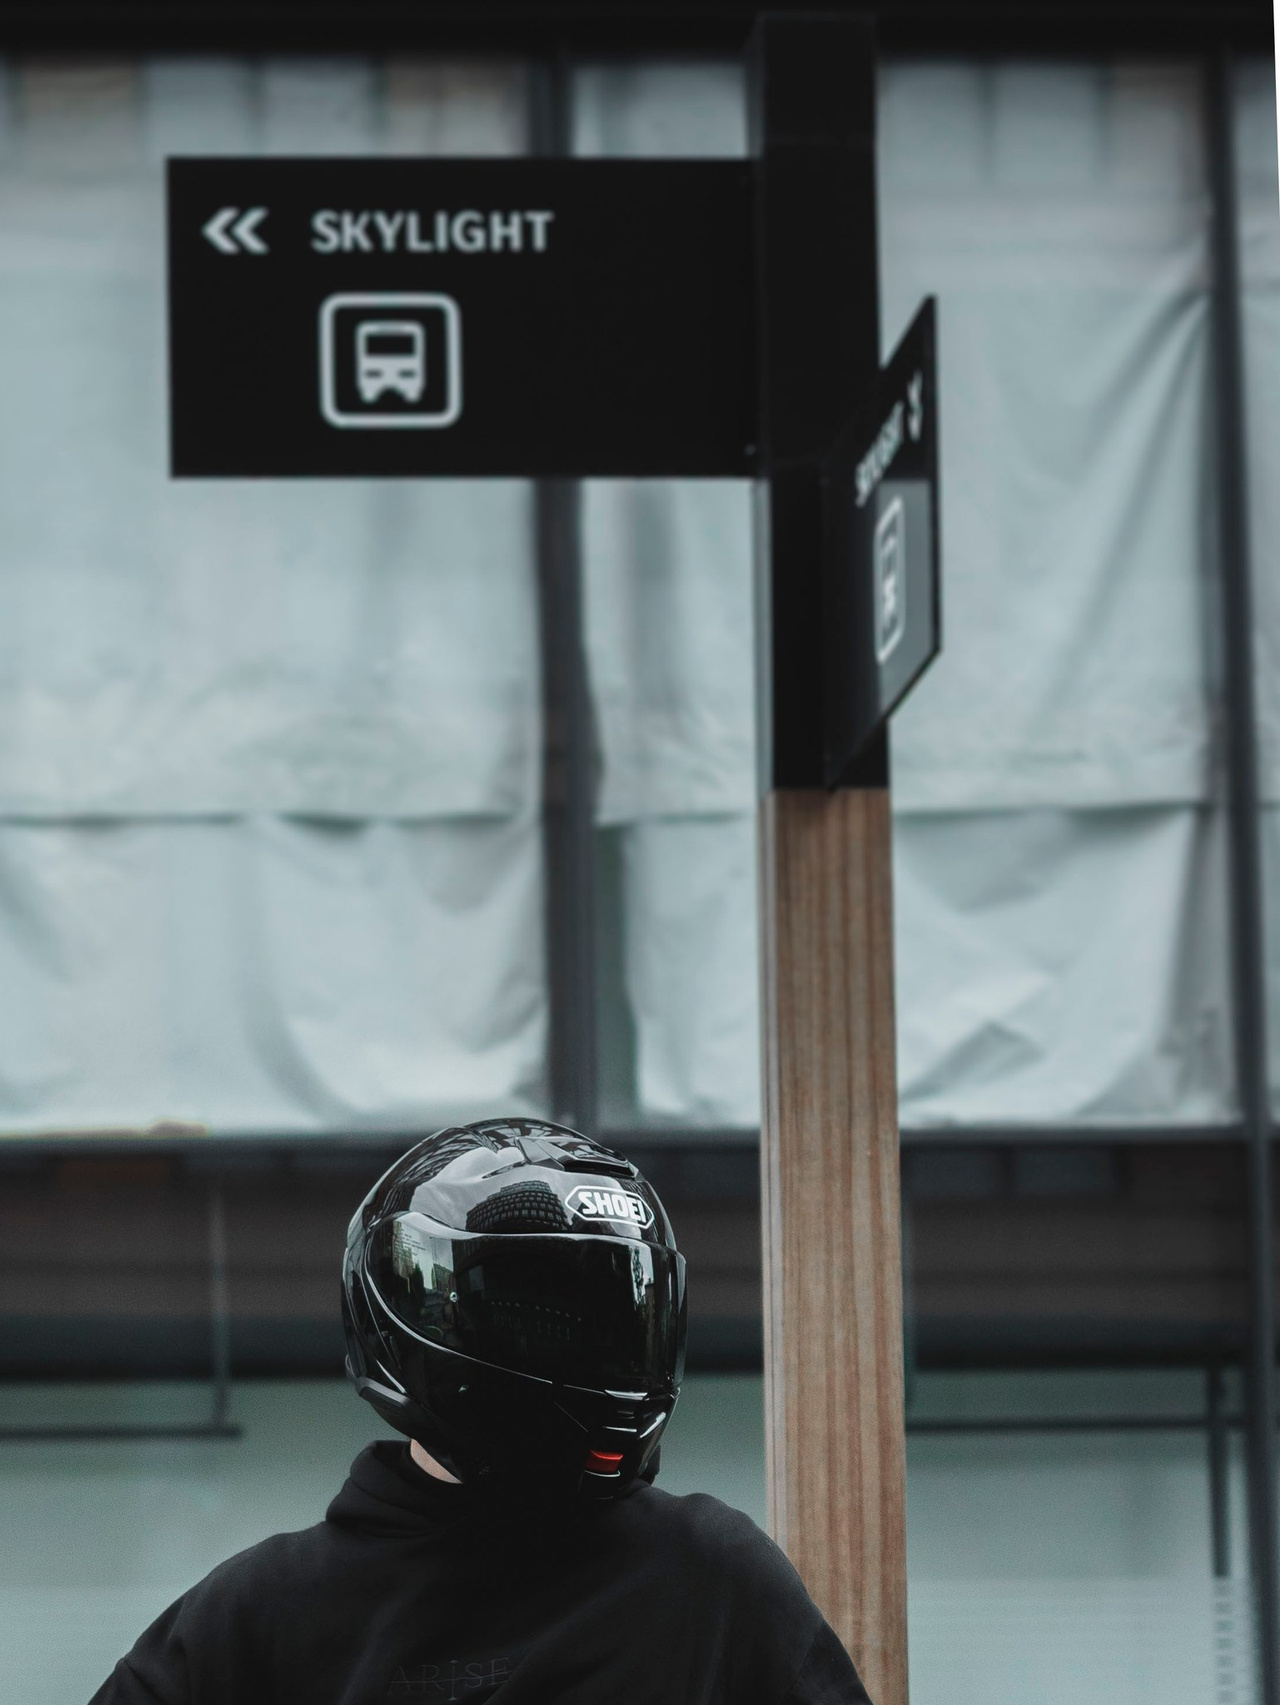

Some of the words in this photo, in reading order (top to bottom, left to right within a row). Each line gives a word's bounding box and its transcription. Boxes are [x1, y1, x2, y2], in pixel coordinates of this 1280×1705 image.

[311, 209, 554, 253] SKYLIGHT
[578, 1191, 647, 1223] SHOEI
[385, 1657, 513, 1702] ARISE
